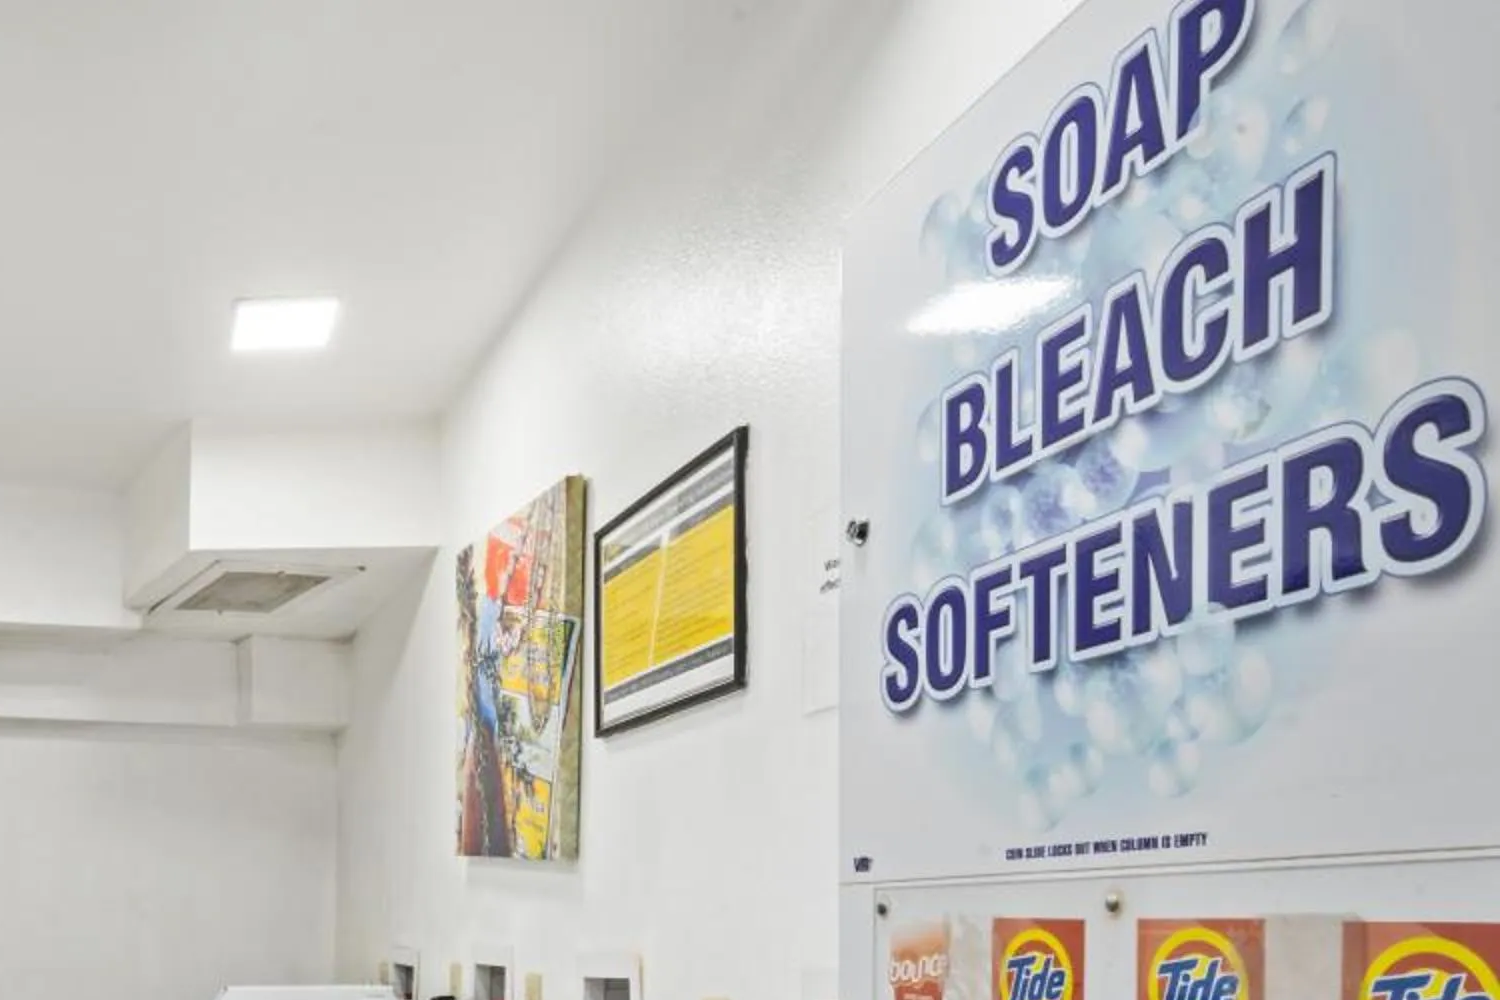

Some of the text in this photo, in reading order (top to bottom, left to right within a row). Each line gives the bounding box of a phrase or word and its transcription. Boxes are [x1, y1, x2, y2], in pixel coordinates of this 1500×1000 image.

[988, 0, 1248, 270] SOAP
[942, 167, 1328, 500] BLEACH
[882, 392, 1474, 704] SOFTENERS
[1047, 843, 1073, 857] LOCKS
[1093, 840, 1117, 853] WHEN
[1120, 836, 1159, 852] COLUMN
[1161, 835, 1171, 849] IS
[1173, 831, 1208, 848] EMPTY
